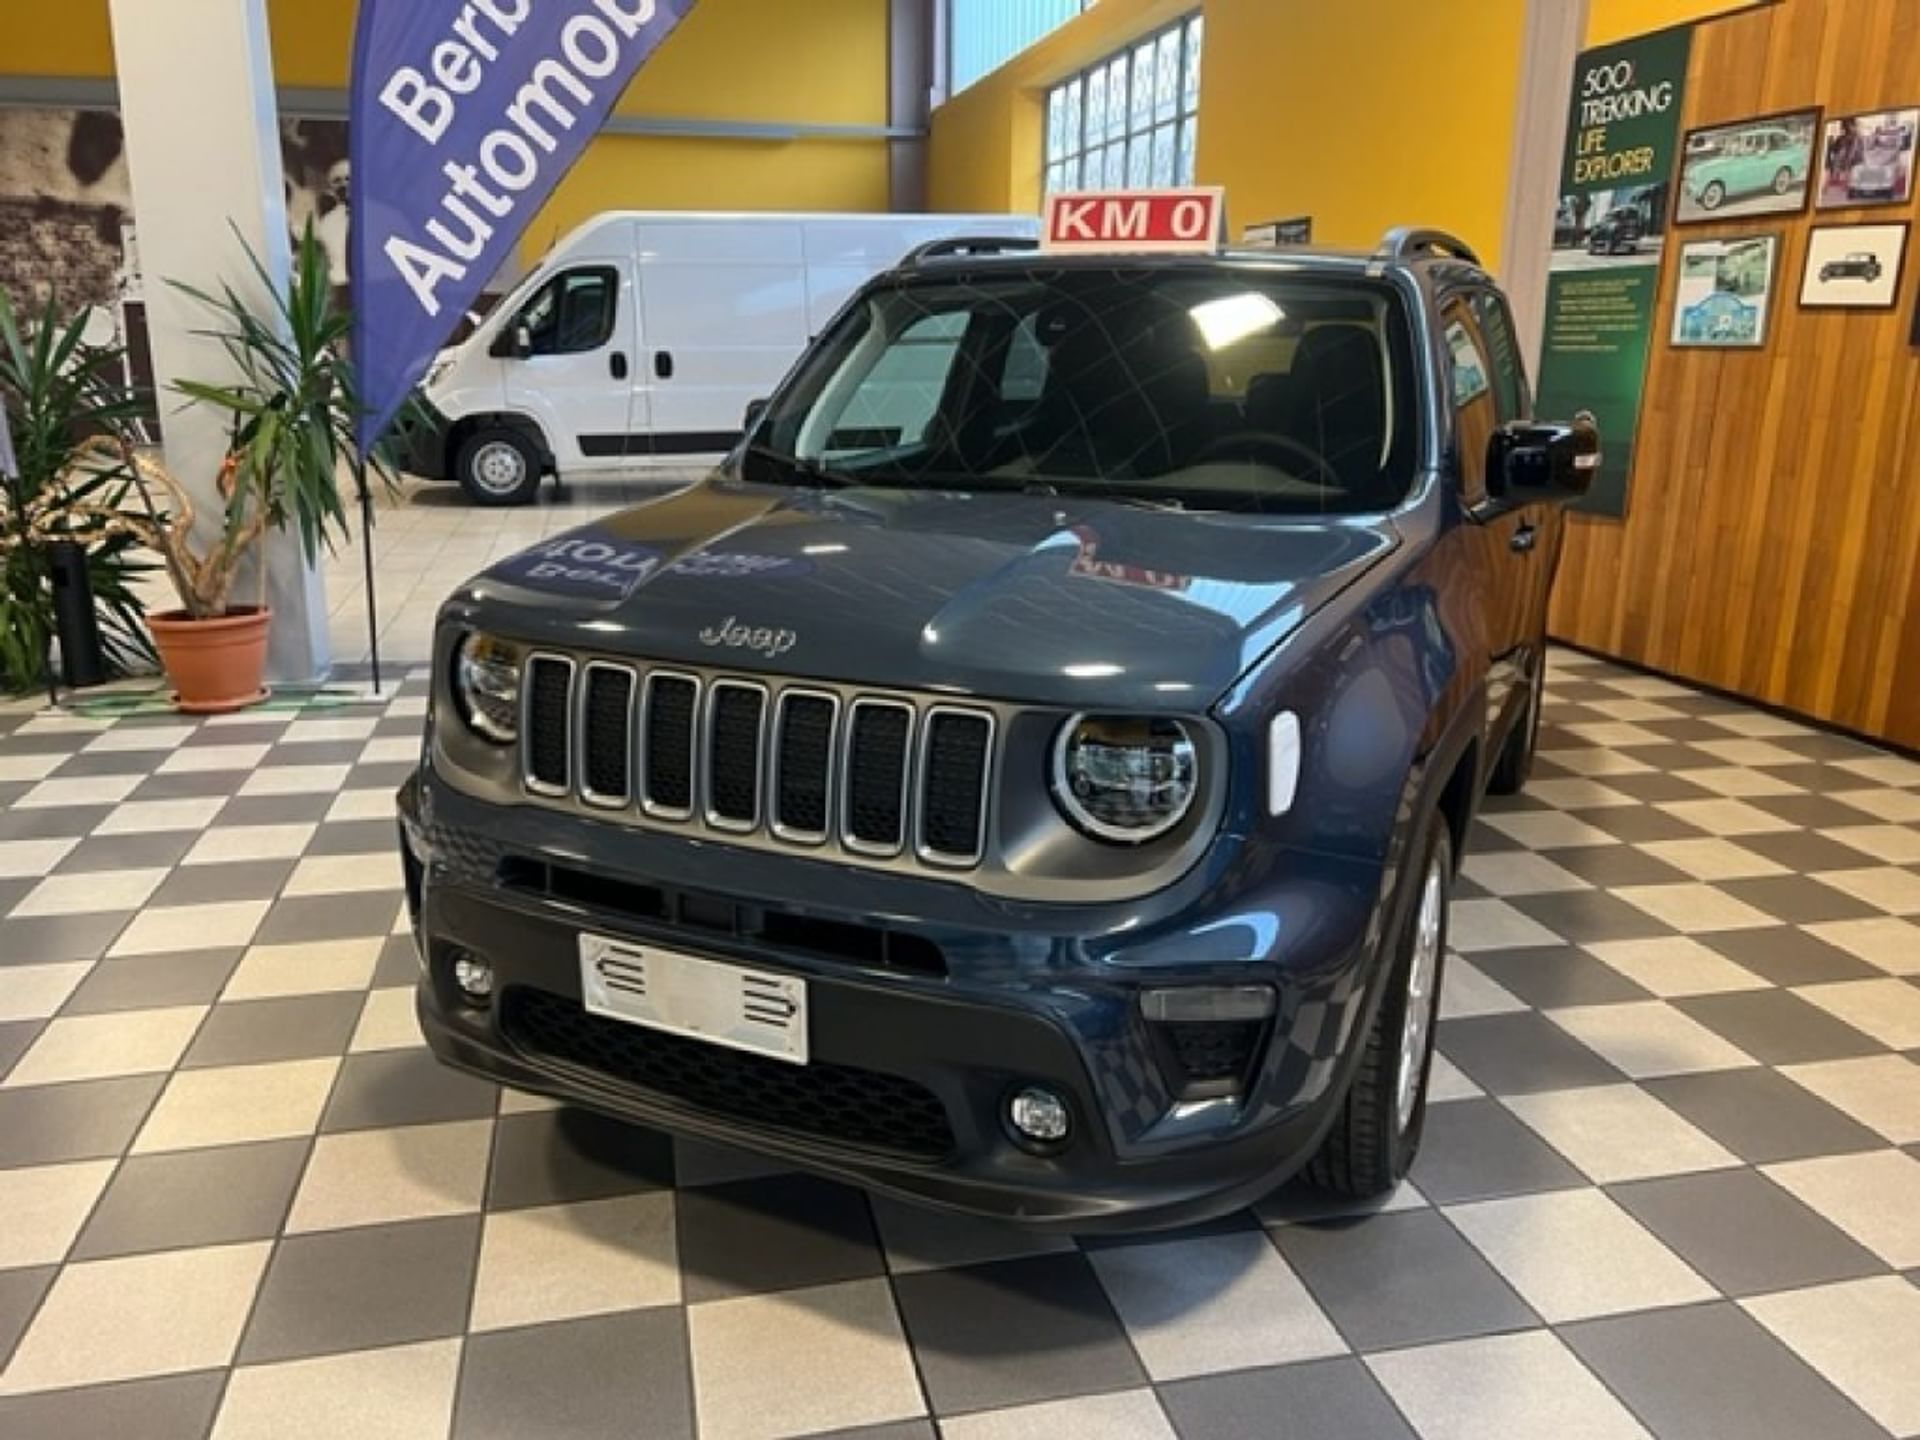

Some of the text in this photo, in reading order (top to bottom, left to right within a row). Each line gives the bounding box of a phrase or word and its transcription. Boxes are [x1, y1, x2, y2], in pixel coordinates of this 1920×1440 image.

[379, 0, 530, 145] Berb
[1581, 81, 1672, 128] TREKKING
[384, 0, 656, 316] Automob
[1577, 127, 1606, 155] LIFE
[1574, 147, 1654, 183] EXPLORER
[1057, 200, 1205, 239] KM 0
[699, 615, 797, 658] Jeep
